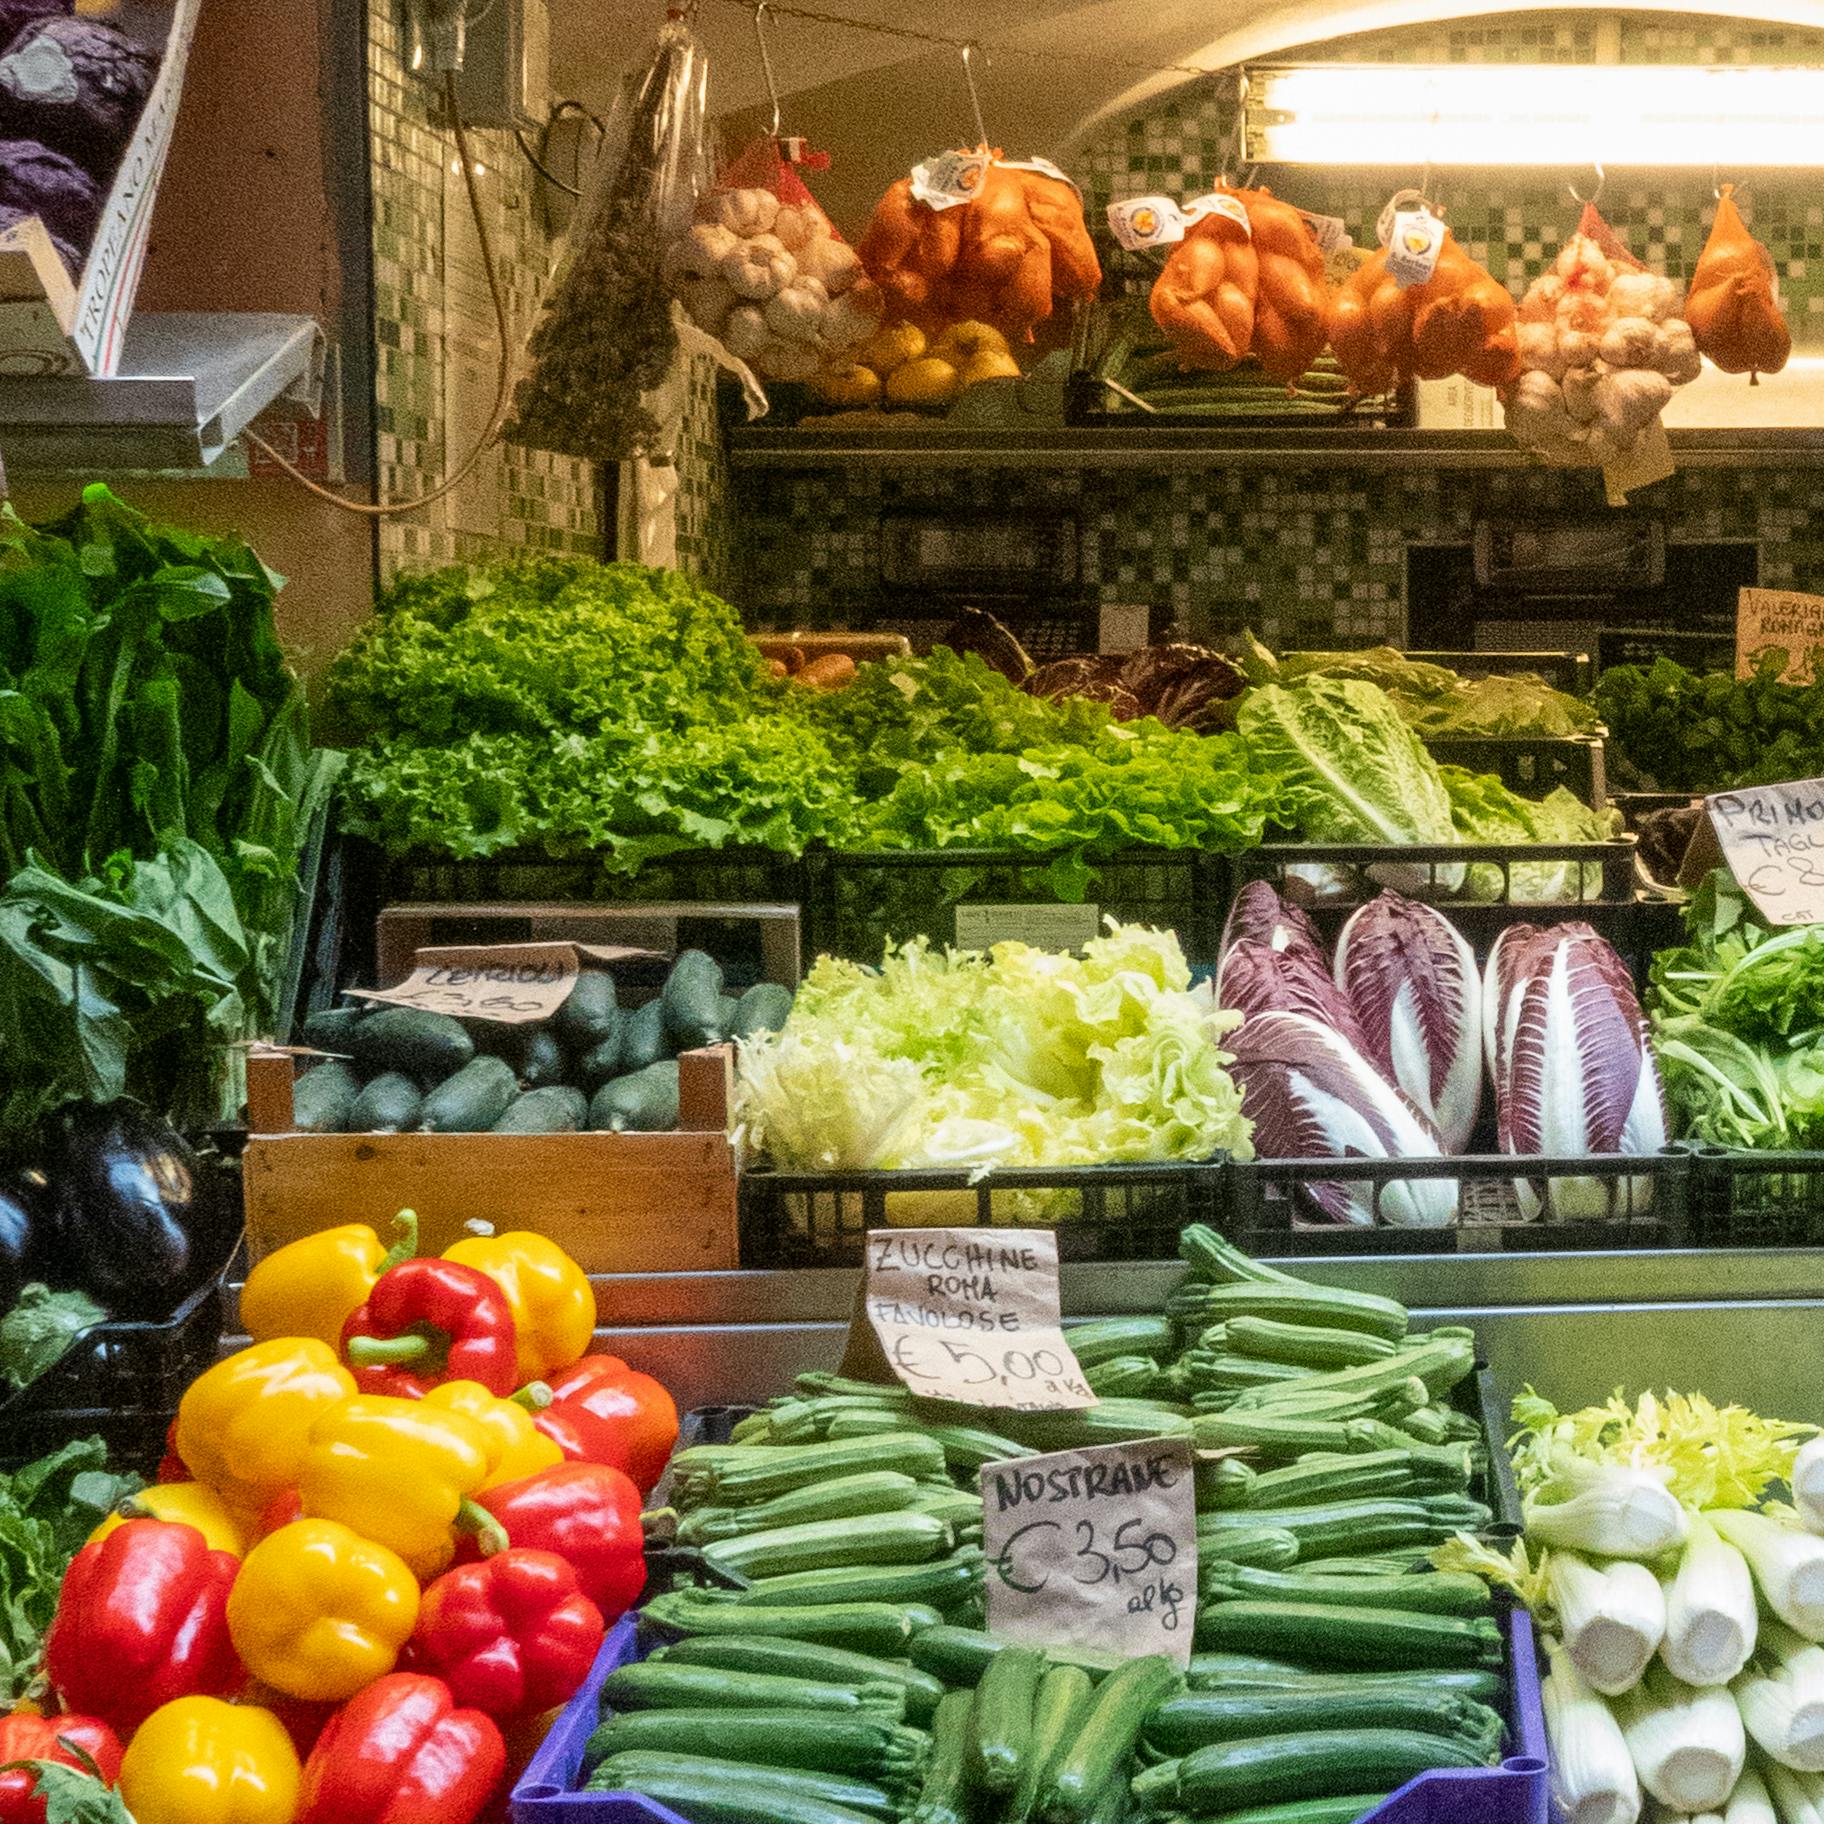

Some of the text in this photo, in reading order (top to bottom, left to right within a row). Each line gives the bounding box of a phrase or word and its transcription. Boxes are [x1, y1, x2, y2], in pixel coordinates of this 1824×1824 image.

[874, 1239, 1040, 1273] ZUCCHINE
[928, 1274, 1000, 1302] ROMA
[875, 1302, 1021, 1333] FAVOLOSE
[997, 1455, 1180, 1512] NOSTRANE
